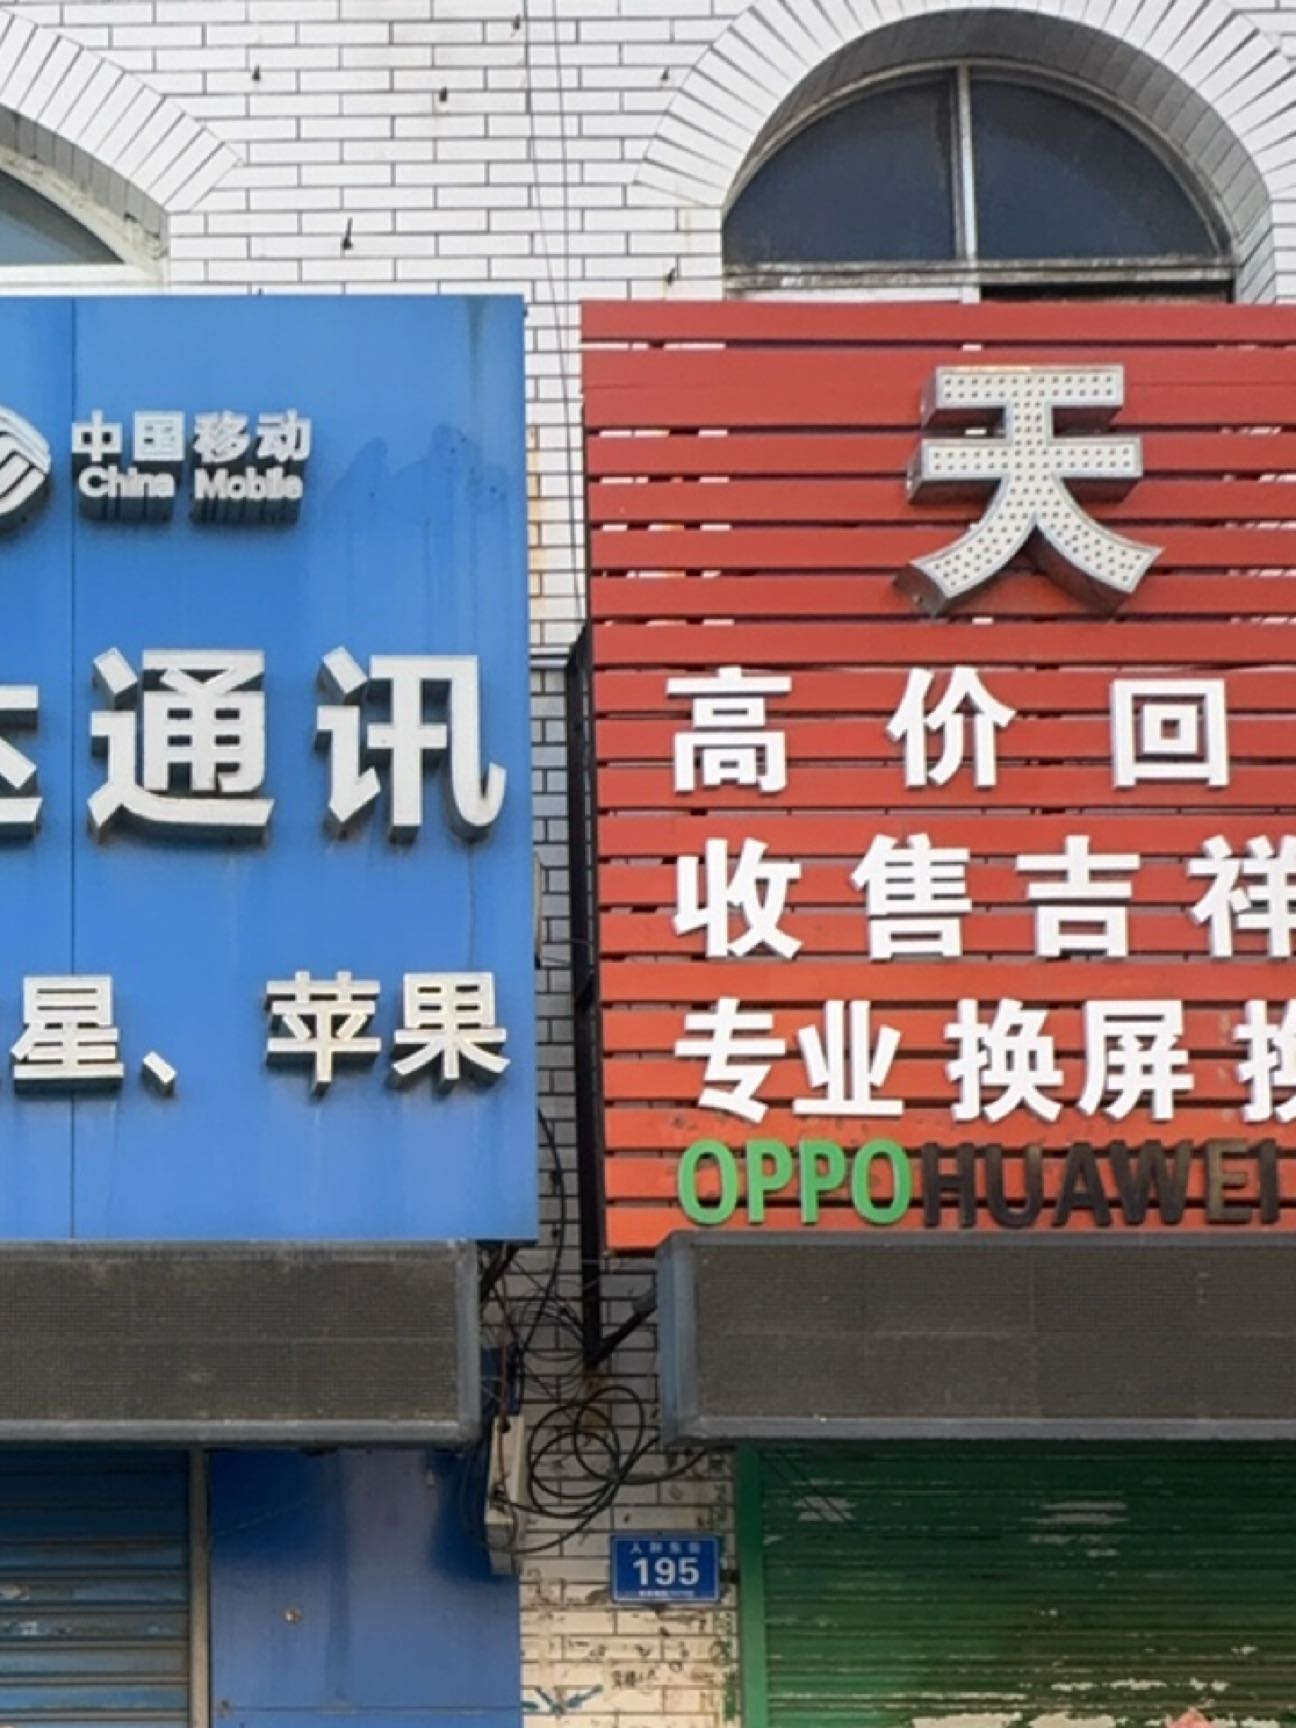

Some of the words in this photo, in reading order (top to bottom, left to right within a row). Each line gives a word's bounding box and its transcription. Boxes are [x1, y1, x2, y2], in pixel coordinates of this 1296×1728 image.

[71, 409, 311, 463] 中国移动
[78, 467, 175, 499] China
[194, 468, 303, 500] Mobile
[908, 363, 1165, 604] 天
[665, 666, 1231, 793] 高价回
[671, 833, 1296, 960] 收售吉祥
[678, 1139, 913, 1226] OPPO
[920, 1138, 1281, 1230] HUAWEI
[632, 1556, 700, 1586] 195
